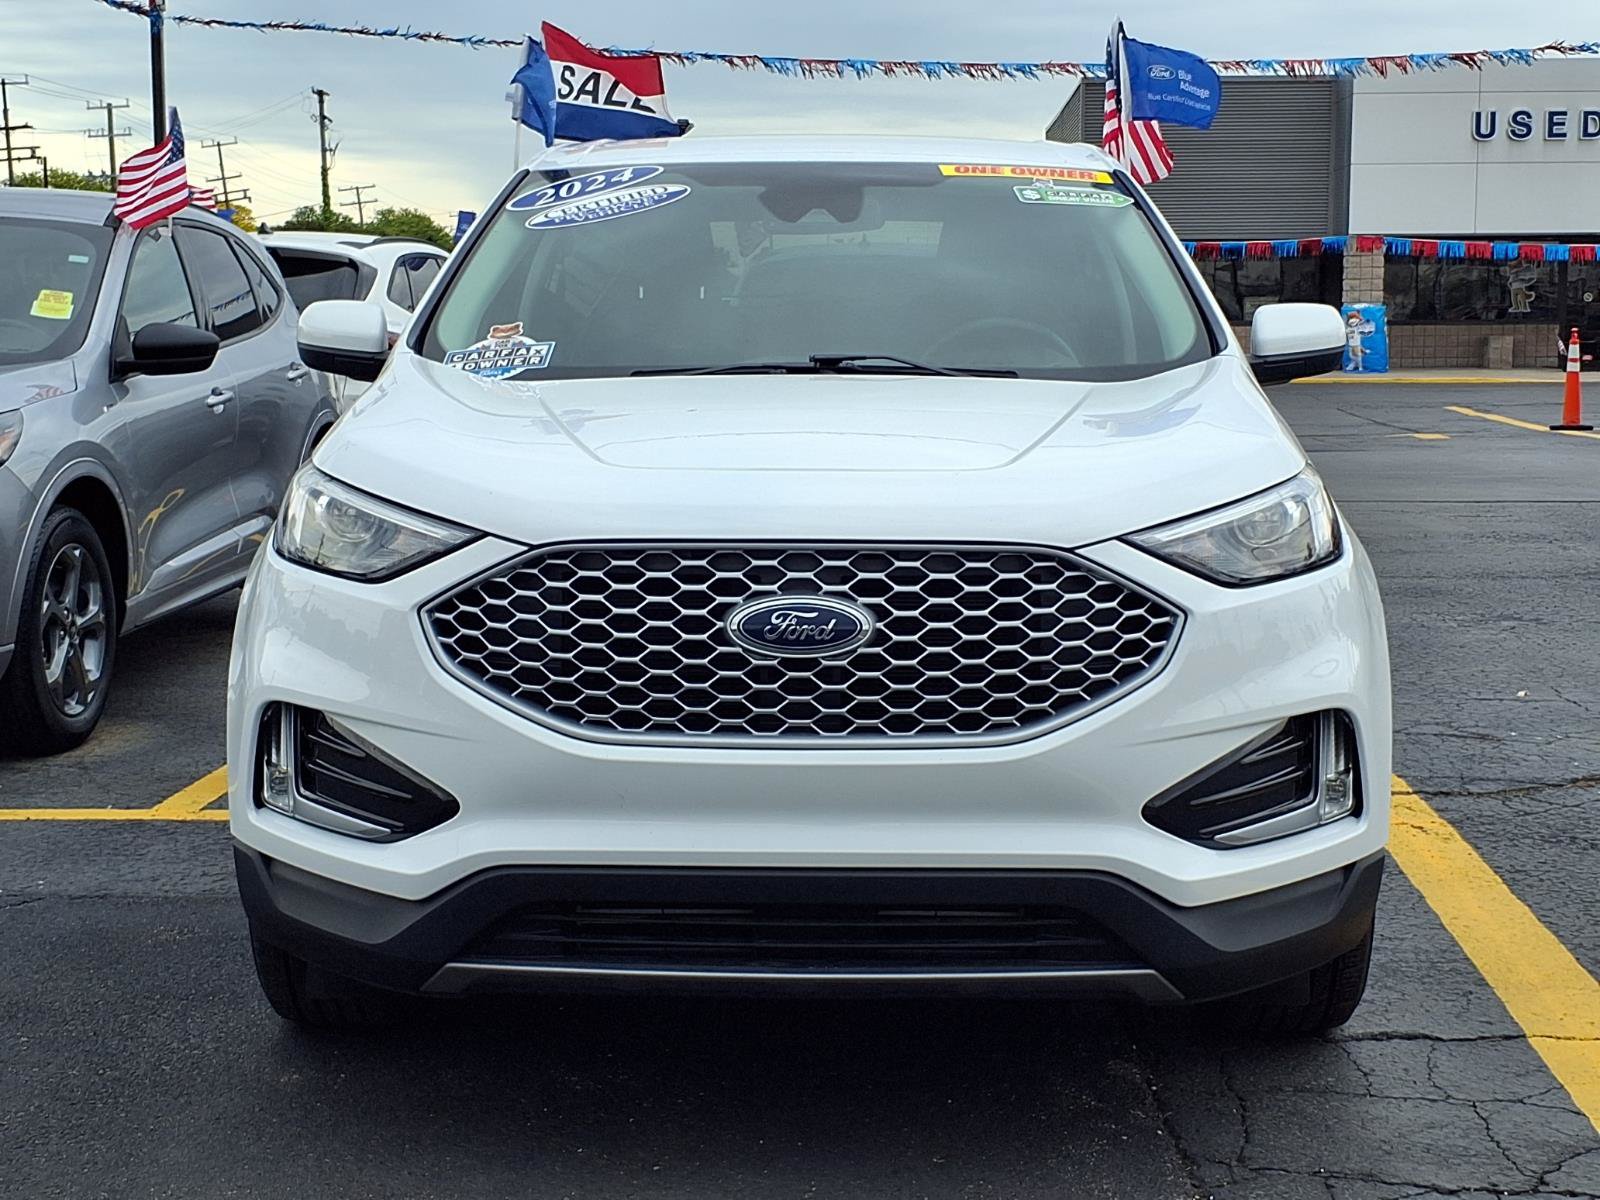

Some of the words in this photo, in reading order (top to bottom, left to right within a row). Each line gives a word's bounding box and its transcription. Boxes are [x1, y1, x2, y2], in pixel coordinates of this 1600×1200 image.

[1150, 66, 1170, 78] Ford
[1473, 110, 1600, 141] USED
[953, 165, 1005, 175] ONE
[1010, 167, 1094, 180] OWNER
[534, 167, 634, 206] 2024
[543, 185, 669, 219] CERTIFIED
[452, 348, 544, 362] CARFAX
[463, 357, 541, 370] OWNER
[763, 610, 837, 641] Ford
